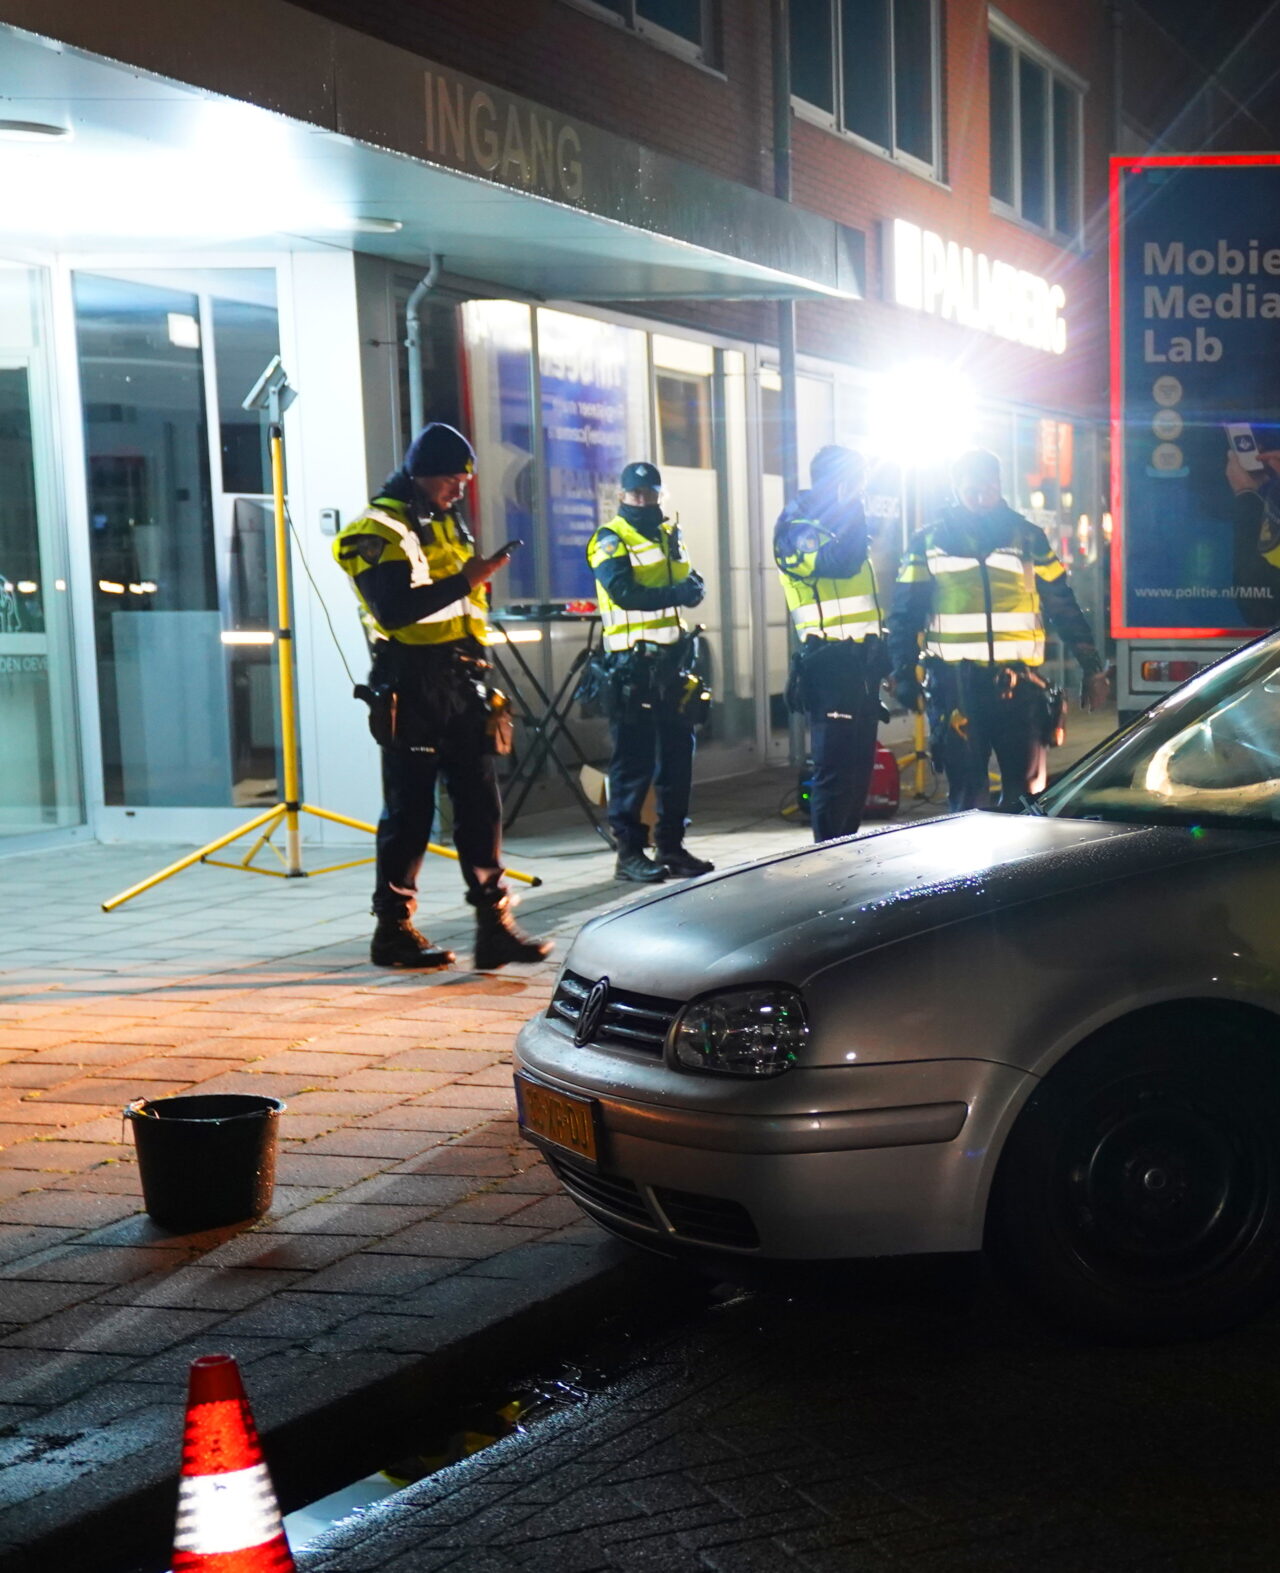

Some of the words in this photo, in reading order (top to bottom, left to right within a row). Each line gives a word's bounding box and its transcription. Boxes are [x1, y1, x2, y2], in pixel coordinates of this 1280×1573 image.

[423, 69, 582, 200] INGANG
[1143, 327, 1223, 364] Lab
[1135, 585, 1274, 601] www.politie.nl/MML
